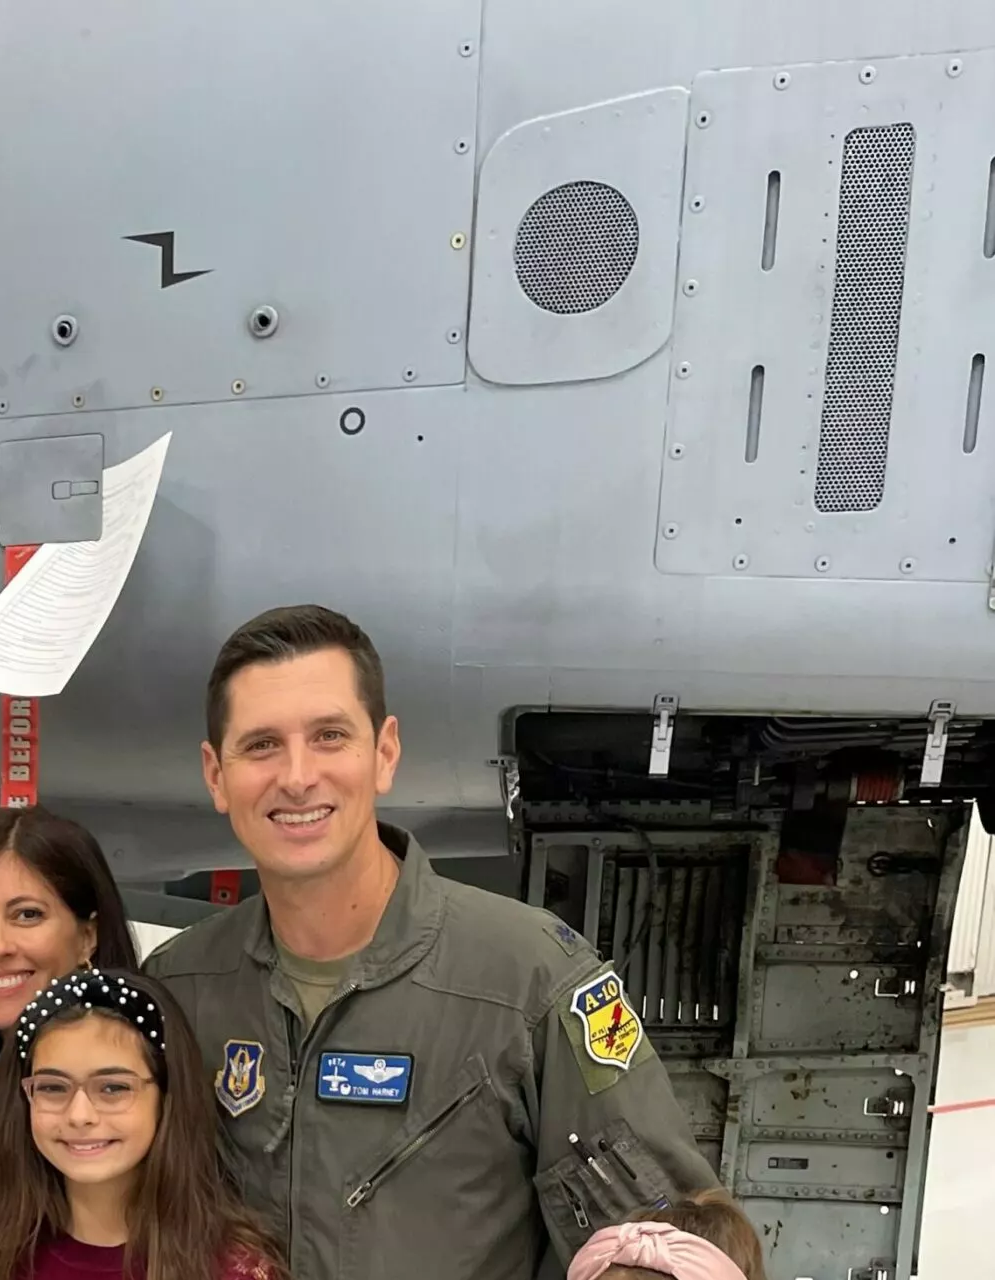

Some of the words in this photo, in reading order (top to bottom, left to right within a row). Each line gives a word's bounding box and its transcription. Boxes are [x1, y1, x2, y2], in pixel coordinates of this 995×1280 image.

[9, 699, 31, 781] BEFOR
[585, 980, 618, 1012] A-10
[352, 1086, 369, 1096] TOM
